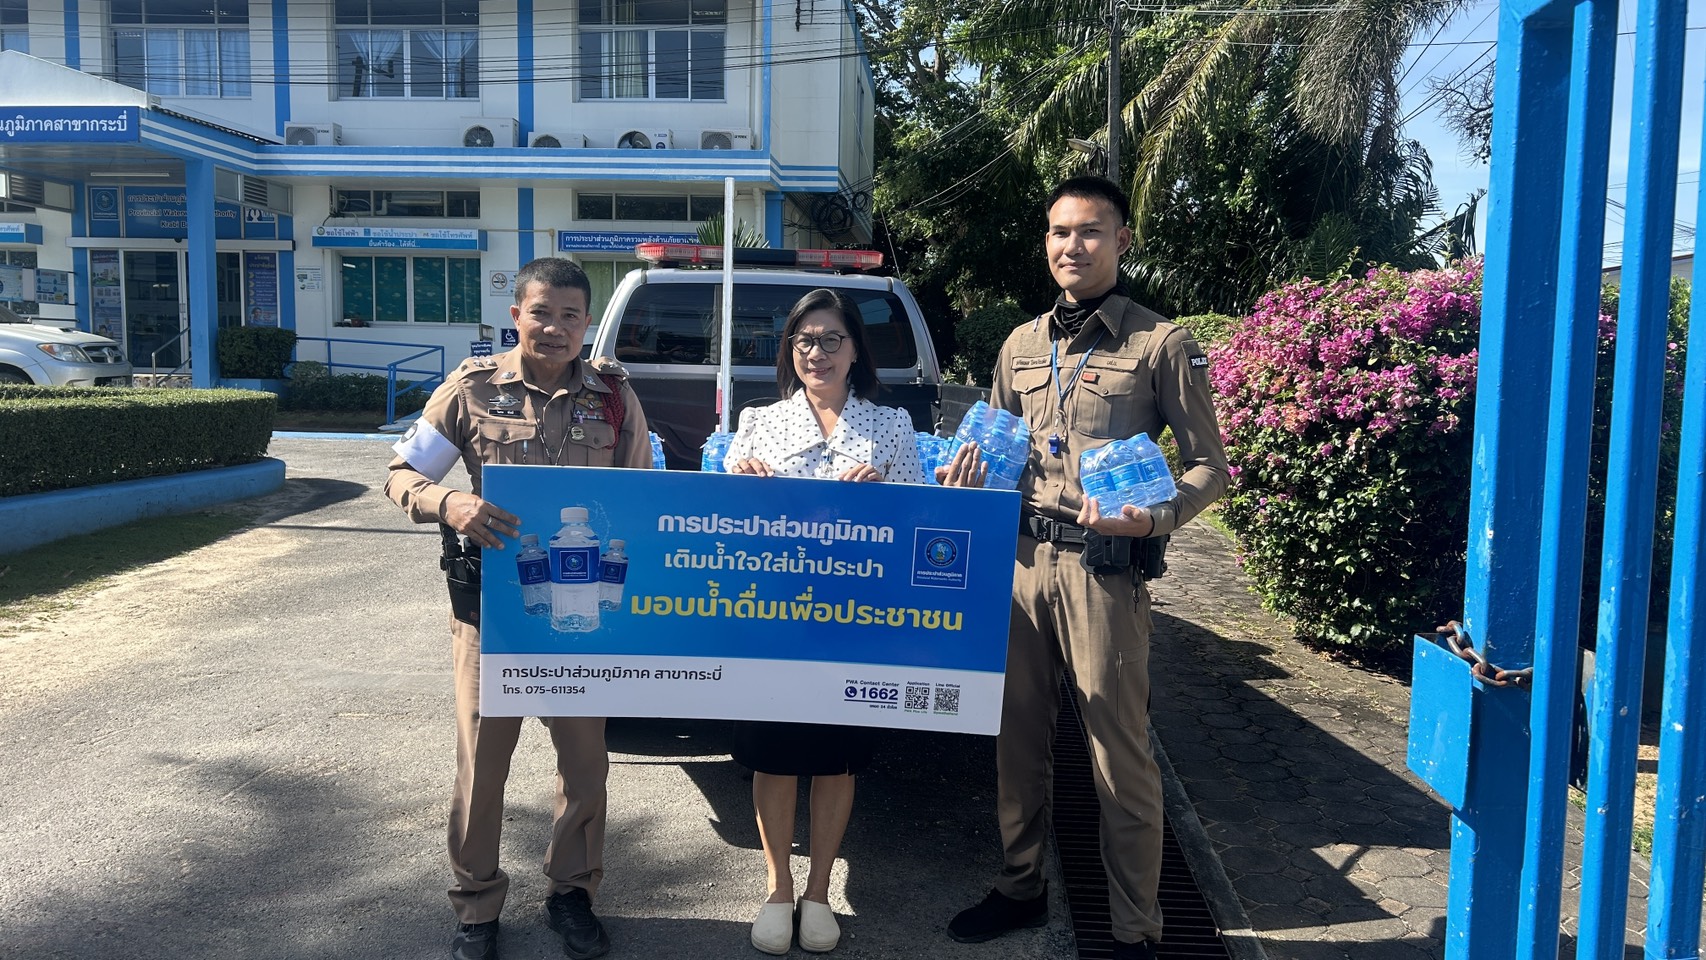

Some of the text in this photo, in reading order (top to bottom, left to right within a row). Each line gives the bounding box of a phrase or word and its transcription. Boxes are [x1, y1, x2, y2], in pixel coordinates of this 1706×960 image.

[128, 193, 188, 206] การประปาส่วนภูมิ
[128, 208, 161, 217] Provincial
[215, 210, 237, 219] thority
[161, 220, 179, 228] Krabi
[657, 513, 895, 546] การประปาส่วนภูมิภาค
[664, 541, 884, 578] เติมน้ำใจใส่น้ำประปา
[630, 580, 963, 631] มอบน้ำดื่มเพื่อประชาชน
[502, 665, 723, 682] การประปาส่วนภูมิภาค สาขากระบี่
[502, 684, 586, 695] โทร. 075-611354
[860, 686, 899, 701] 1662
